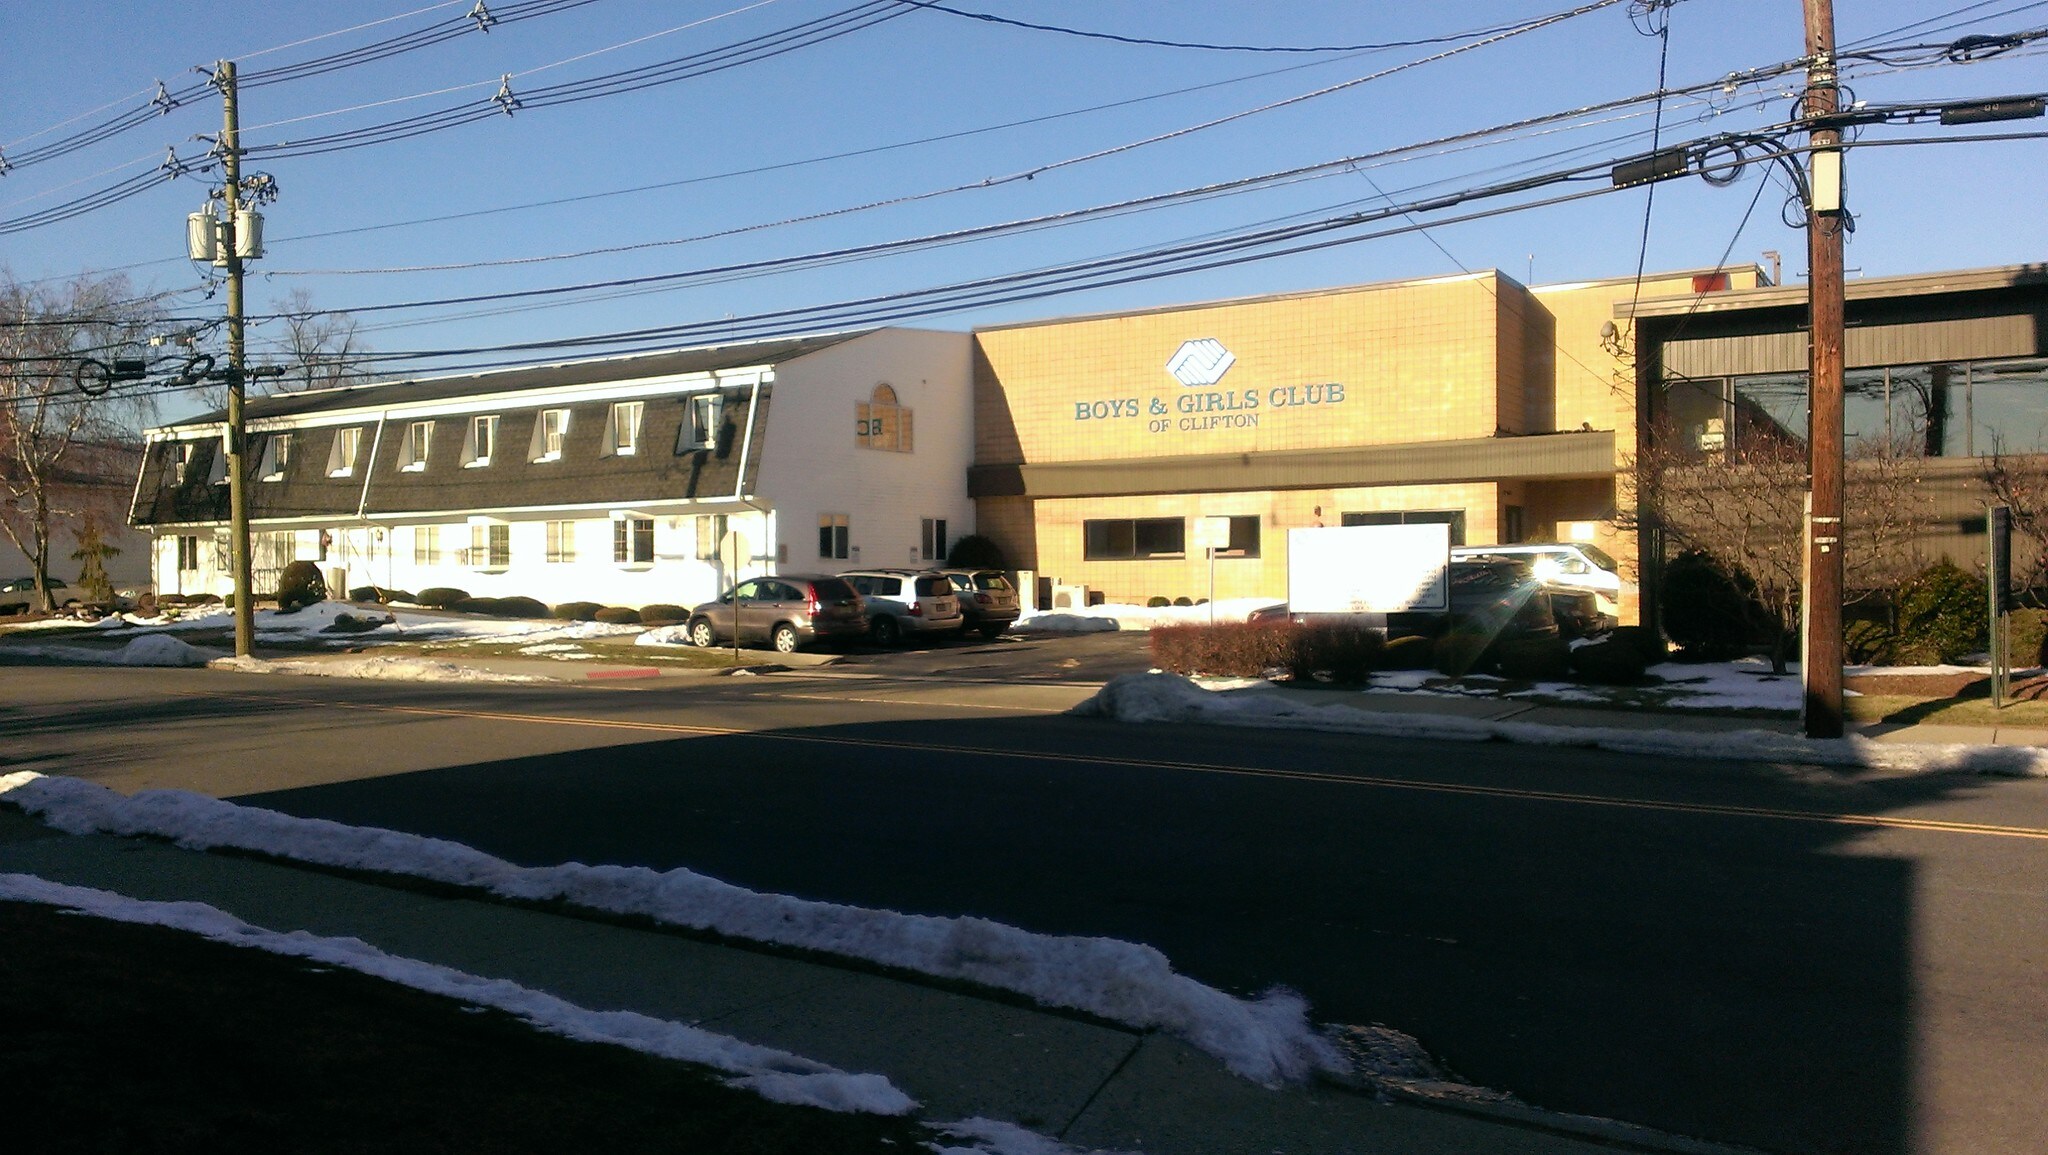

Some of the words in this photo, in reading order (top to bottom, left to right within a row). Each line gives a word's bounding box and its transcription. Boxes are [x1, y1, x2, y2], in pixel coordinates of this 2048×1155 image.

[1075, 398, 1139, 420] BOYS
[1149, 396, 1168, 415] &
[1177, 389, 1259, 413] GIRLS
[1269, 383, 1345, 407] CLUB
[1149, 419, 1171, 433] OF
[1179, 413, 1259, 431] CLIFTON
